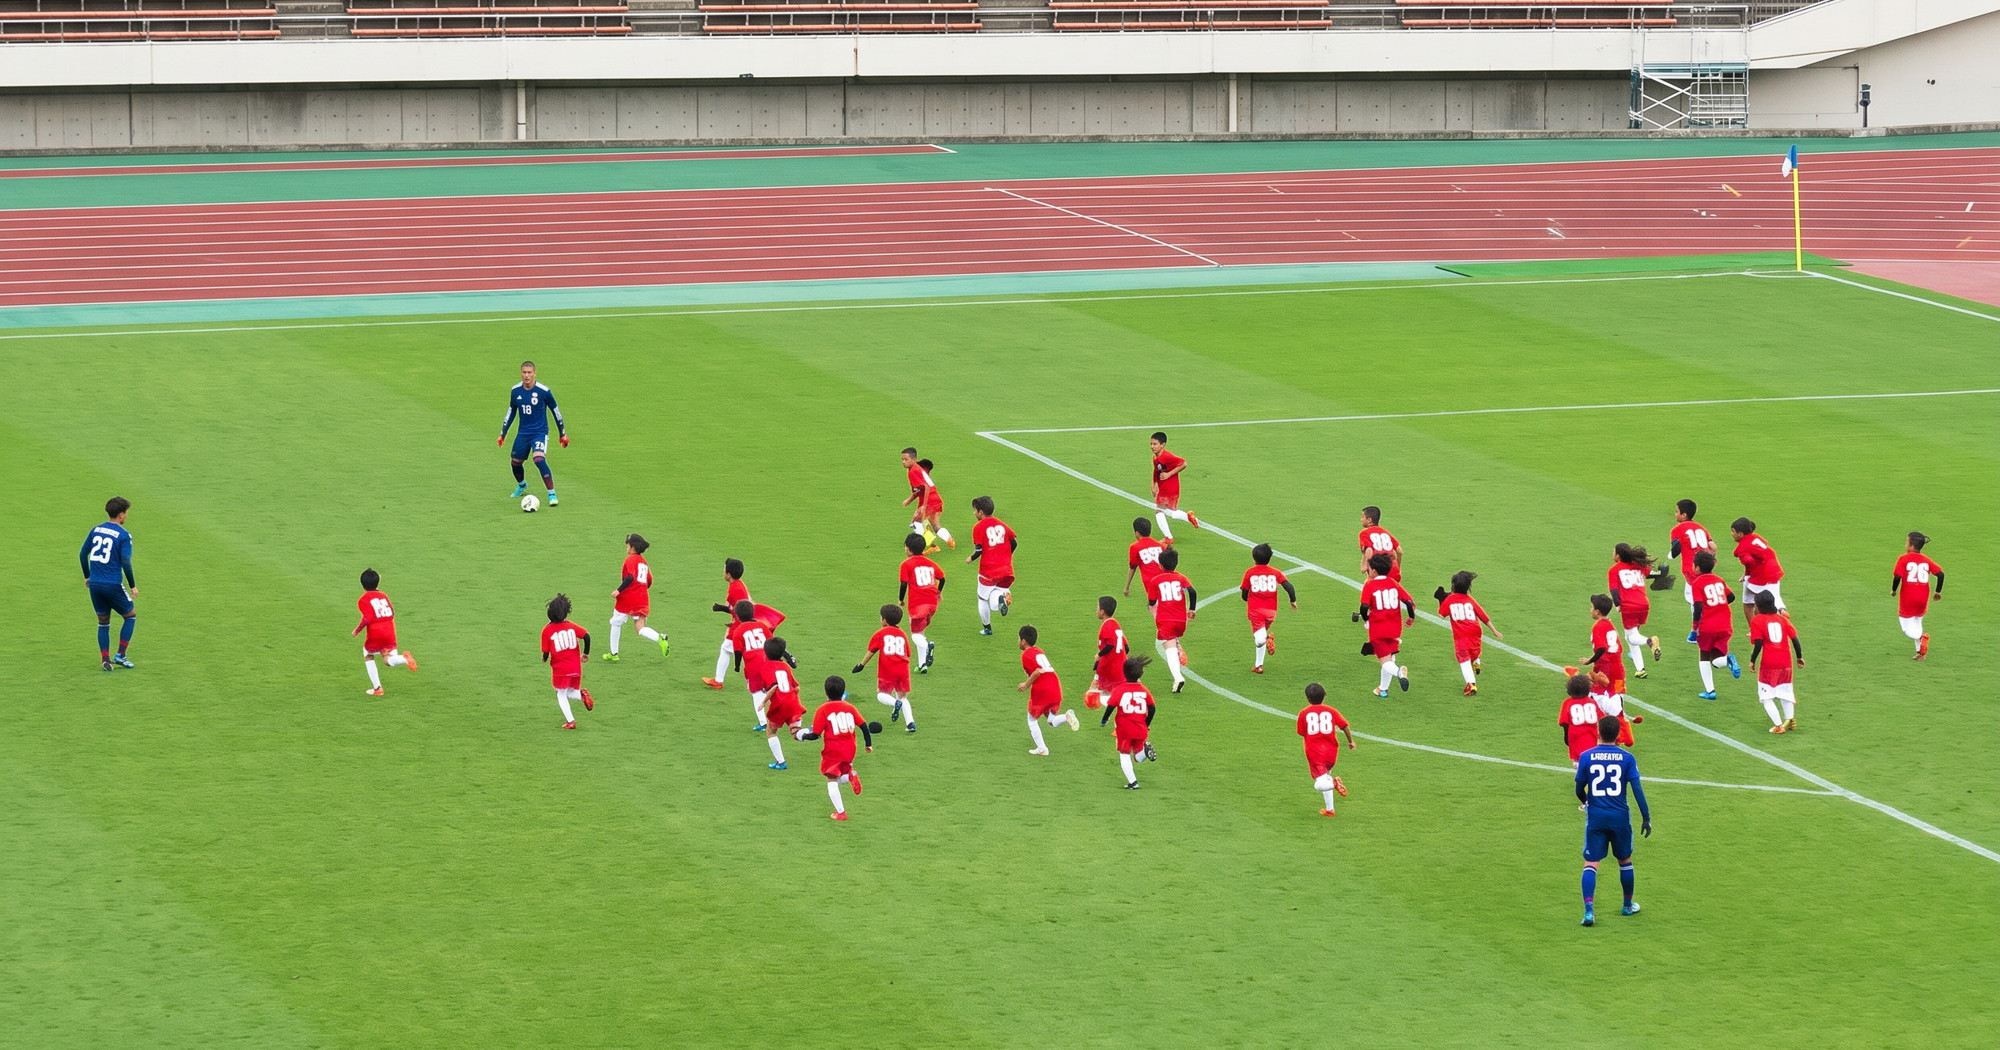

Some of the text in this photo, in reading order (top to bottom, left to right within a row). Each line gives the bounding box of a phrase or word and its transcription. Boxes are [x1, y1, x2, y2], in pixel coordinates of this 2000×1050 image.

[521, 405, 532, 415] 18
[1685, 528, 1708, 549] 10
[89, 535, 114, 565] 23
[1906, 562, 1930, 584] 26
[883, 634, 905, 656] 88
[1305, 711, 1332, 736] 88
[1590, 765, 1622, 797] 23
